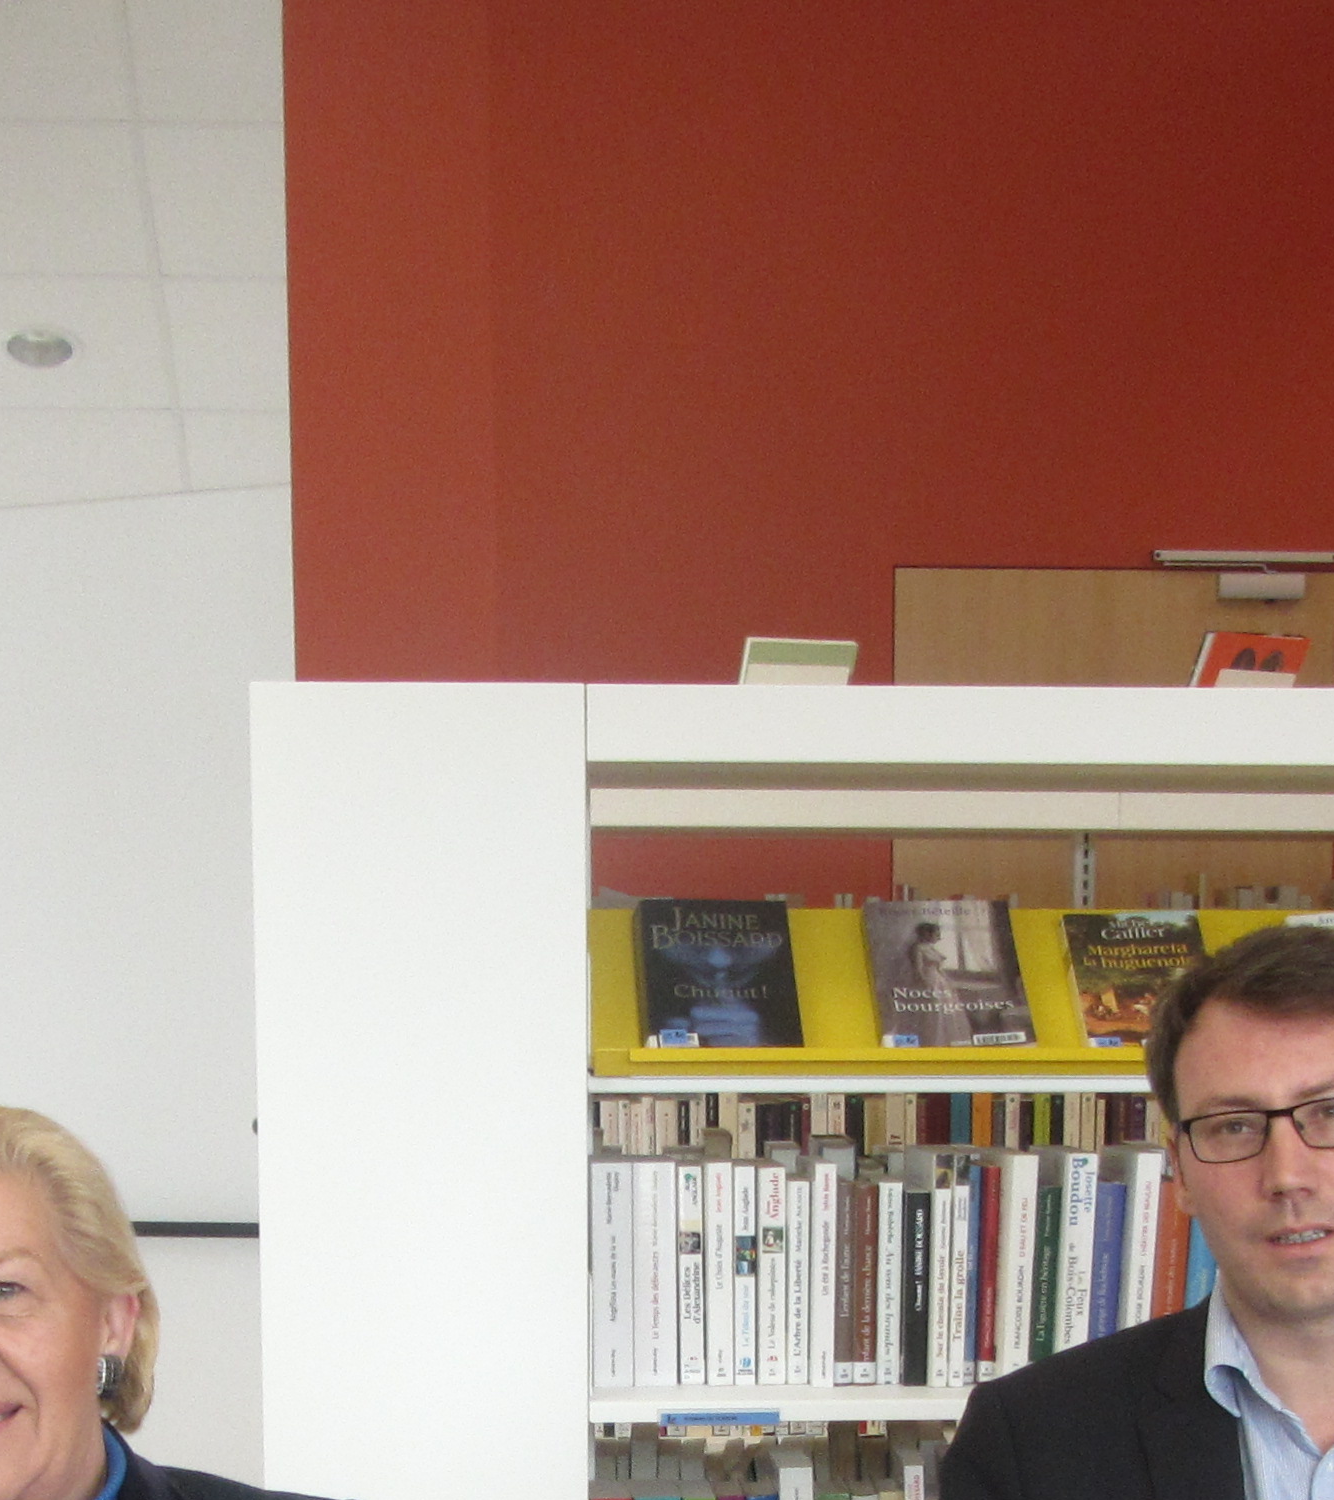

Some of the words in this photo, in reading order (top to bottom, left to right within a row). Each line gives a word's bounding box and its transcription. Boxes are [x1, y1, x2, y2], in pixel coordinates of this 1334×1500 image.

[672, 907, 759, 932] JANINE
[650, 925, 782, 949] BOISSARD
[892, 987, 952, 1000] Noces
[894, 999, 1015, 1014] bourgeoises
[767, 1172, 782, 1221] Anglade
[1068, 1157, 1084, 1226] Boudou
[1083, 1171, 1096, 1213] Josette
[792, 1259, 802, 1294] Liberté
[954, 1250, 965, 1285] grolle
[682, 1267, 692, 1300] Délices
[691, 1262, 701, 1324] d'Alexandrine
[715, 1281, 723, 1290] Le
[821, 1286, 829, 1296] Un
[953, 1288, 963, 1300] la
[1016, 1265, 1025, 1303] BOURDIN
[683, 1303, 692, 1320] Les
[792, 1296, 802, 1305] la
[1063, 1256, 1078, 1345] Bois-Colombes
[1076, 1288, 1088, 1316] Feux
[792, 1307, 802, 1319] de
[861, 1314, 871, 1323] la
[792, 1321, 802, 1357] L'Arbre
[861, 1325, 871, 1336] de
[936, 1331, 944, 1340] le
[936, 1342, 944, 1358] Sur
